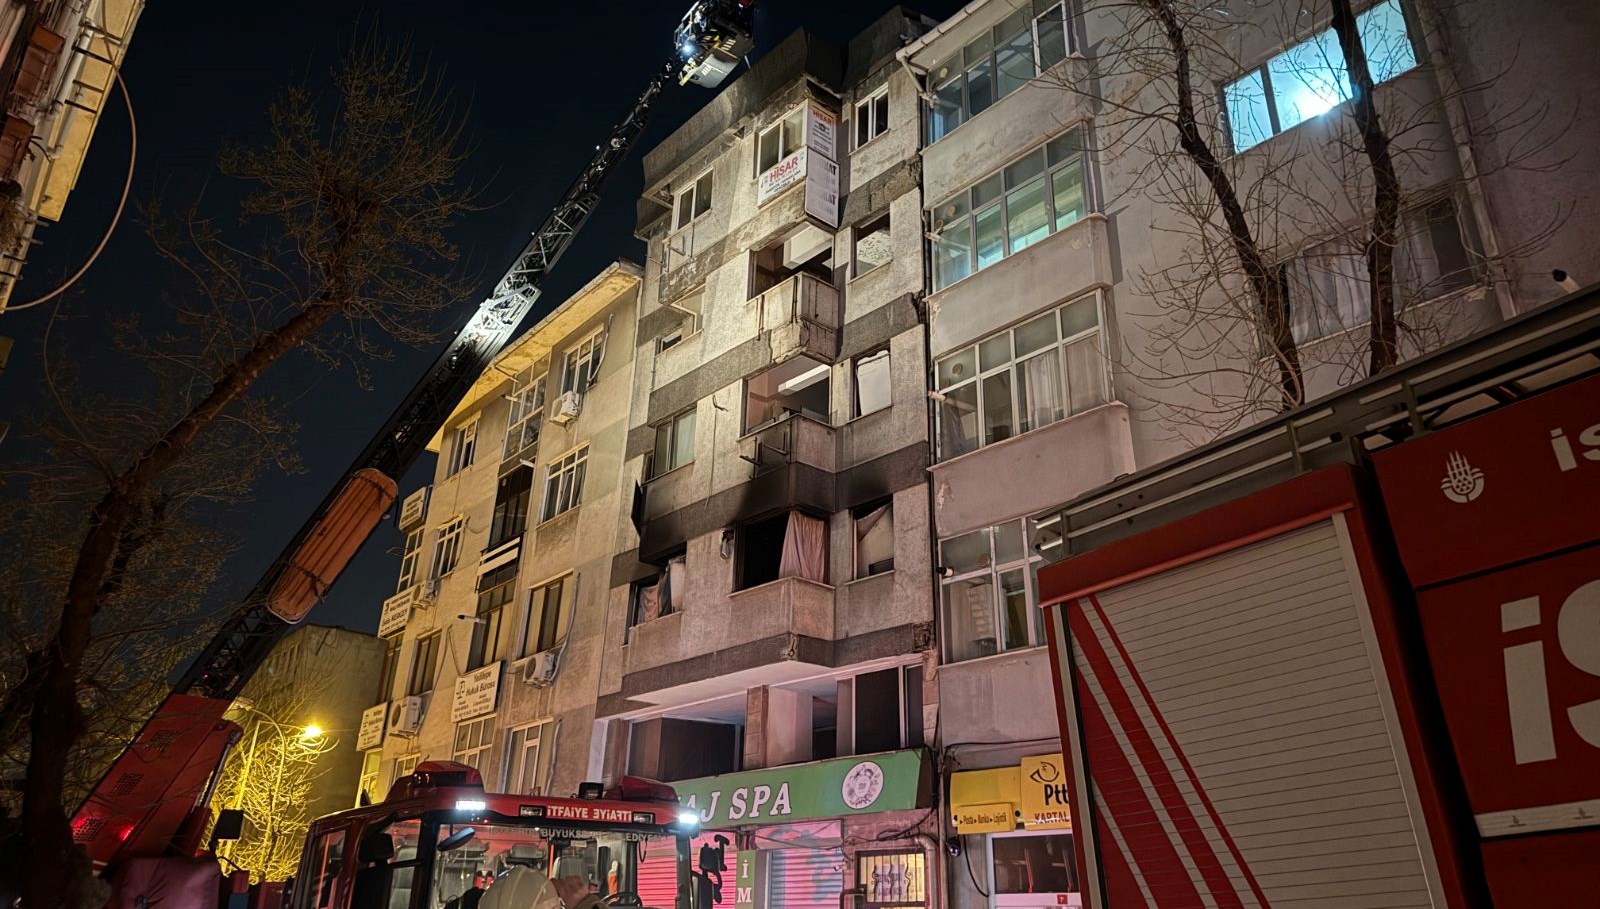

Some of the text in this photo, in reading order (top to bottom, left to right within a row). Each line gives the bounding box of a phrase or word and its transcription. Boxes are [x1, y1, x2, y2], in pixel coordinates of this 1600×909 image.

[678, 782, 792, 823] AJ SPA
[1044, 783, 1069, 806] Ptt
[1034, 811, 1070, 824] KARTAL
